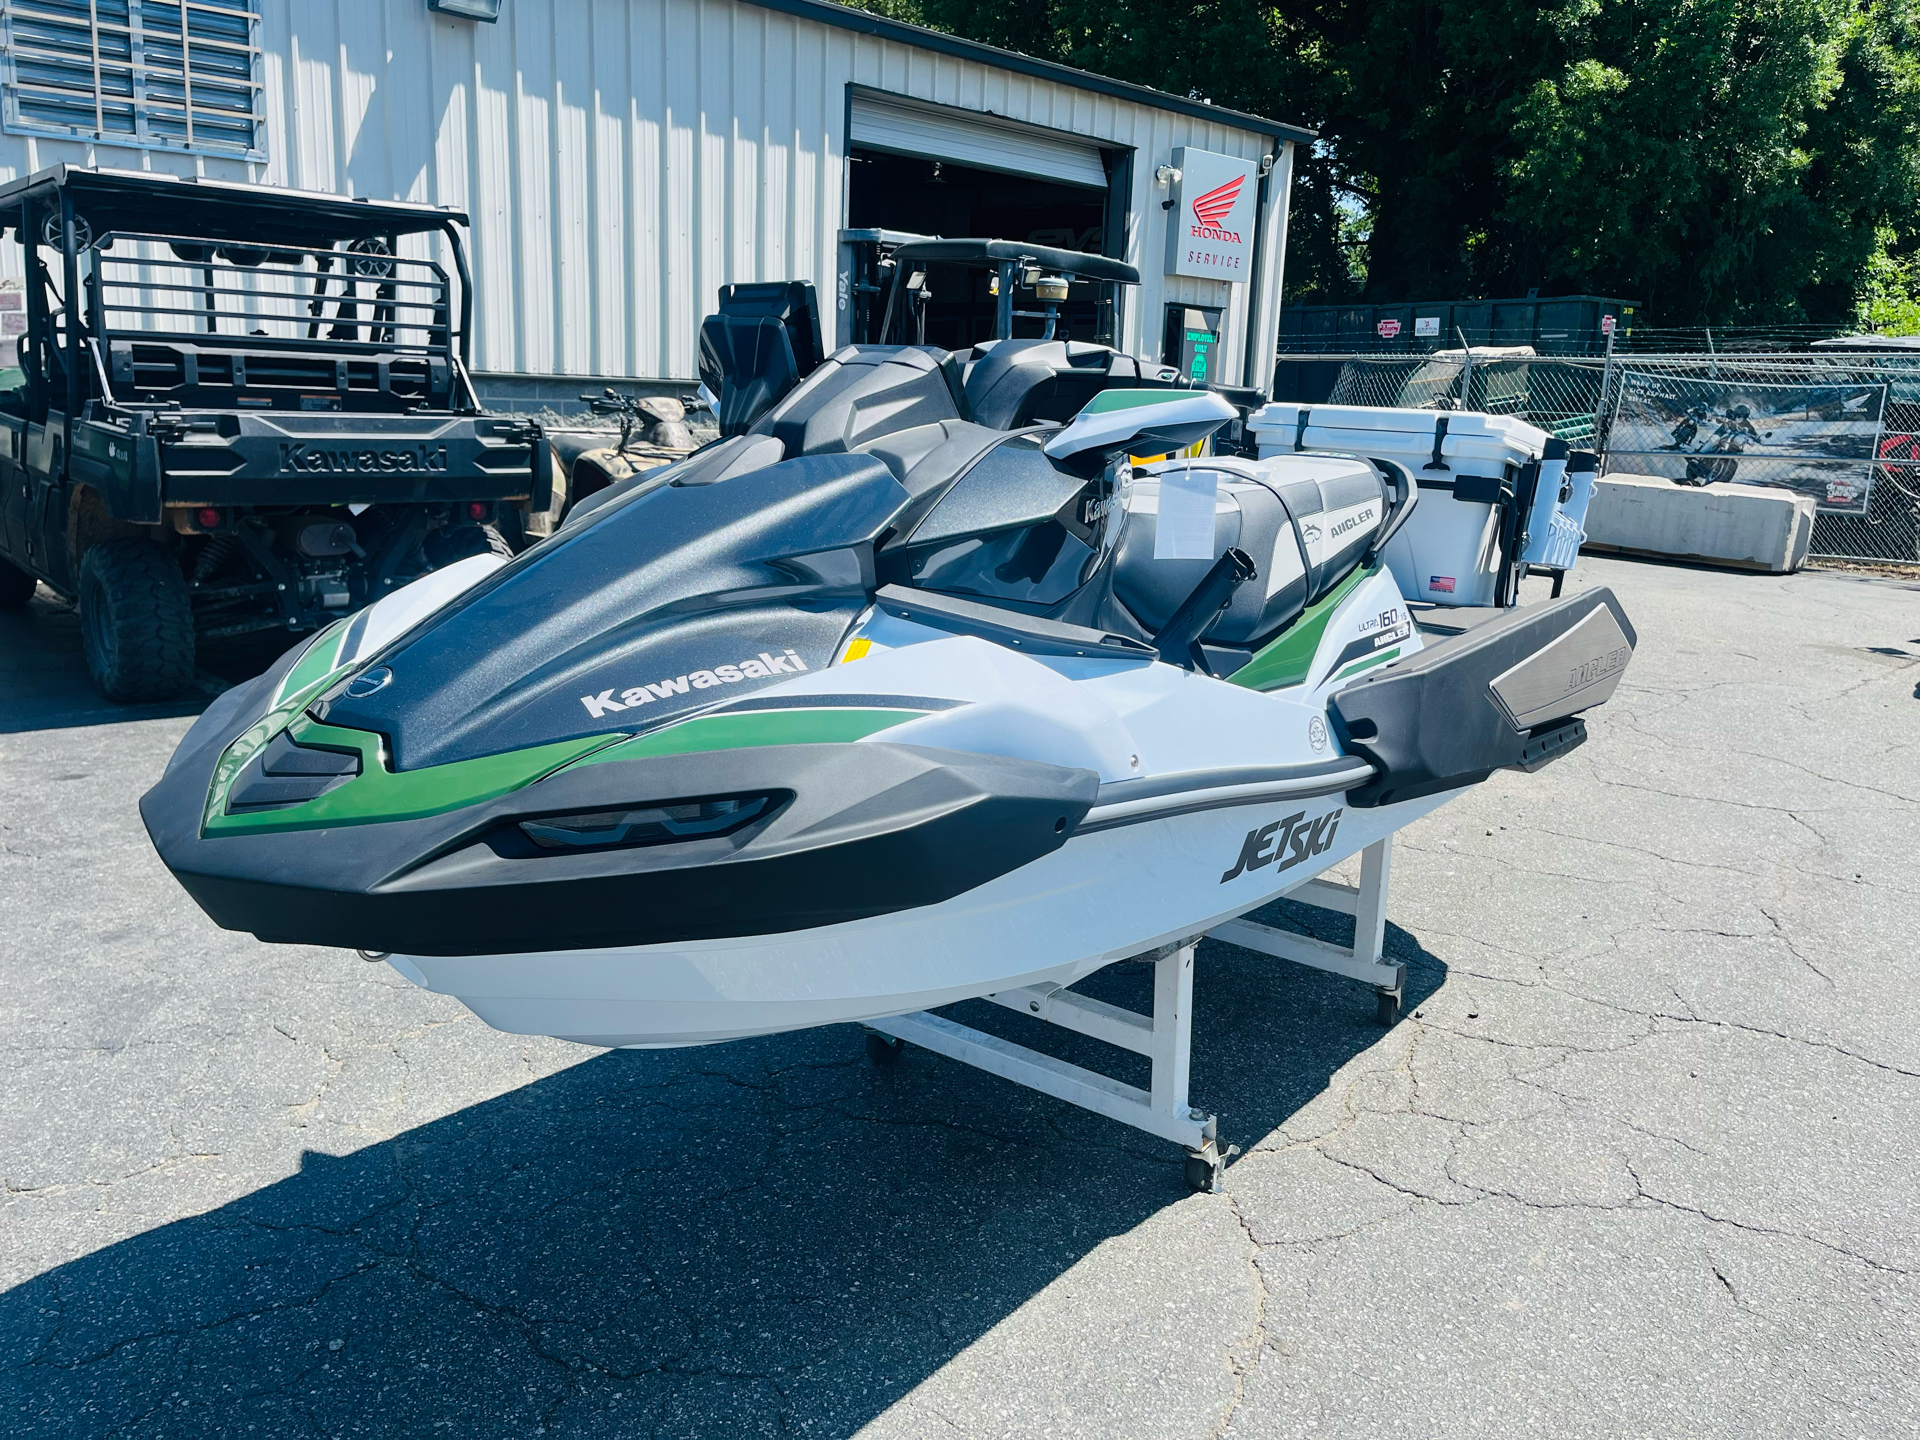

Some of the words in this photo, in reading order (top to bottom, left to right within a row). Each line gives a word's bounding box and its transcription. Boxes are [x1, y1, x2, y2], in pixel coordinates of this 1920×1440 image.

[1190, 225, 1242, 244] HONDA
[1188, 250, 1240, 269] SERVICE
[838, 270, 849, 311] Yale
[279, 443, 447, 473] Kawasaki
[1330, 508, 1374, 539] ANGLER
[1379, 608, 1398, 629] 160
[1373, 626, 1410, 648] ANGLER
[580, 649, 809, 719] Kawasaki
[1564, 646, 1626, 692] ANGLER
